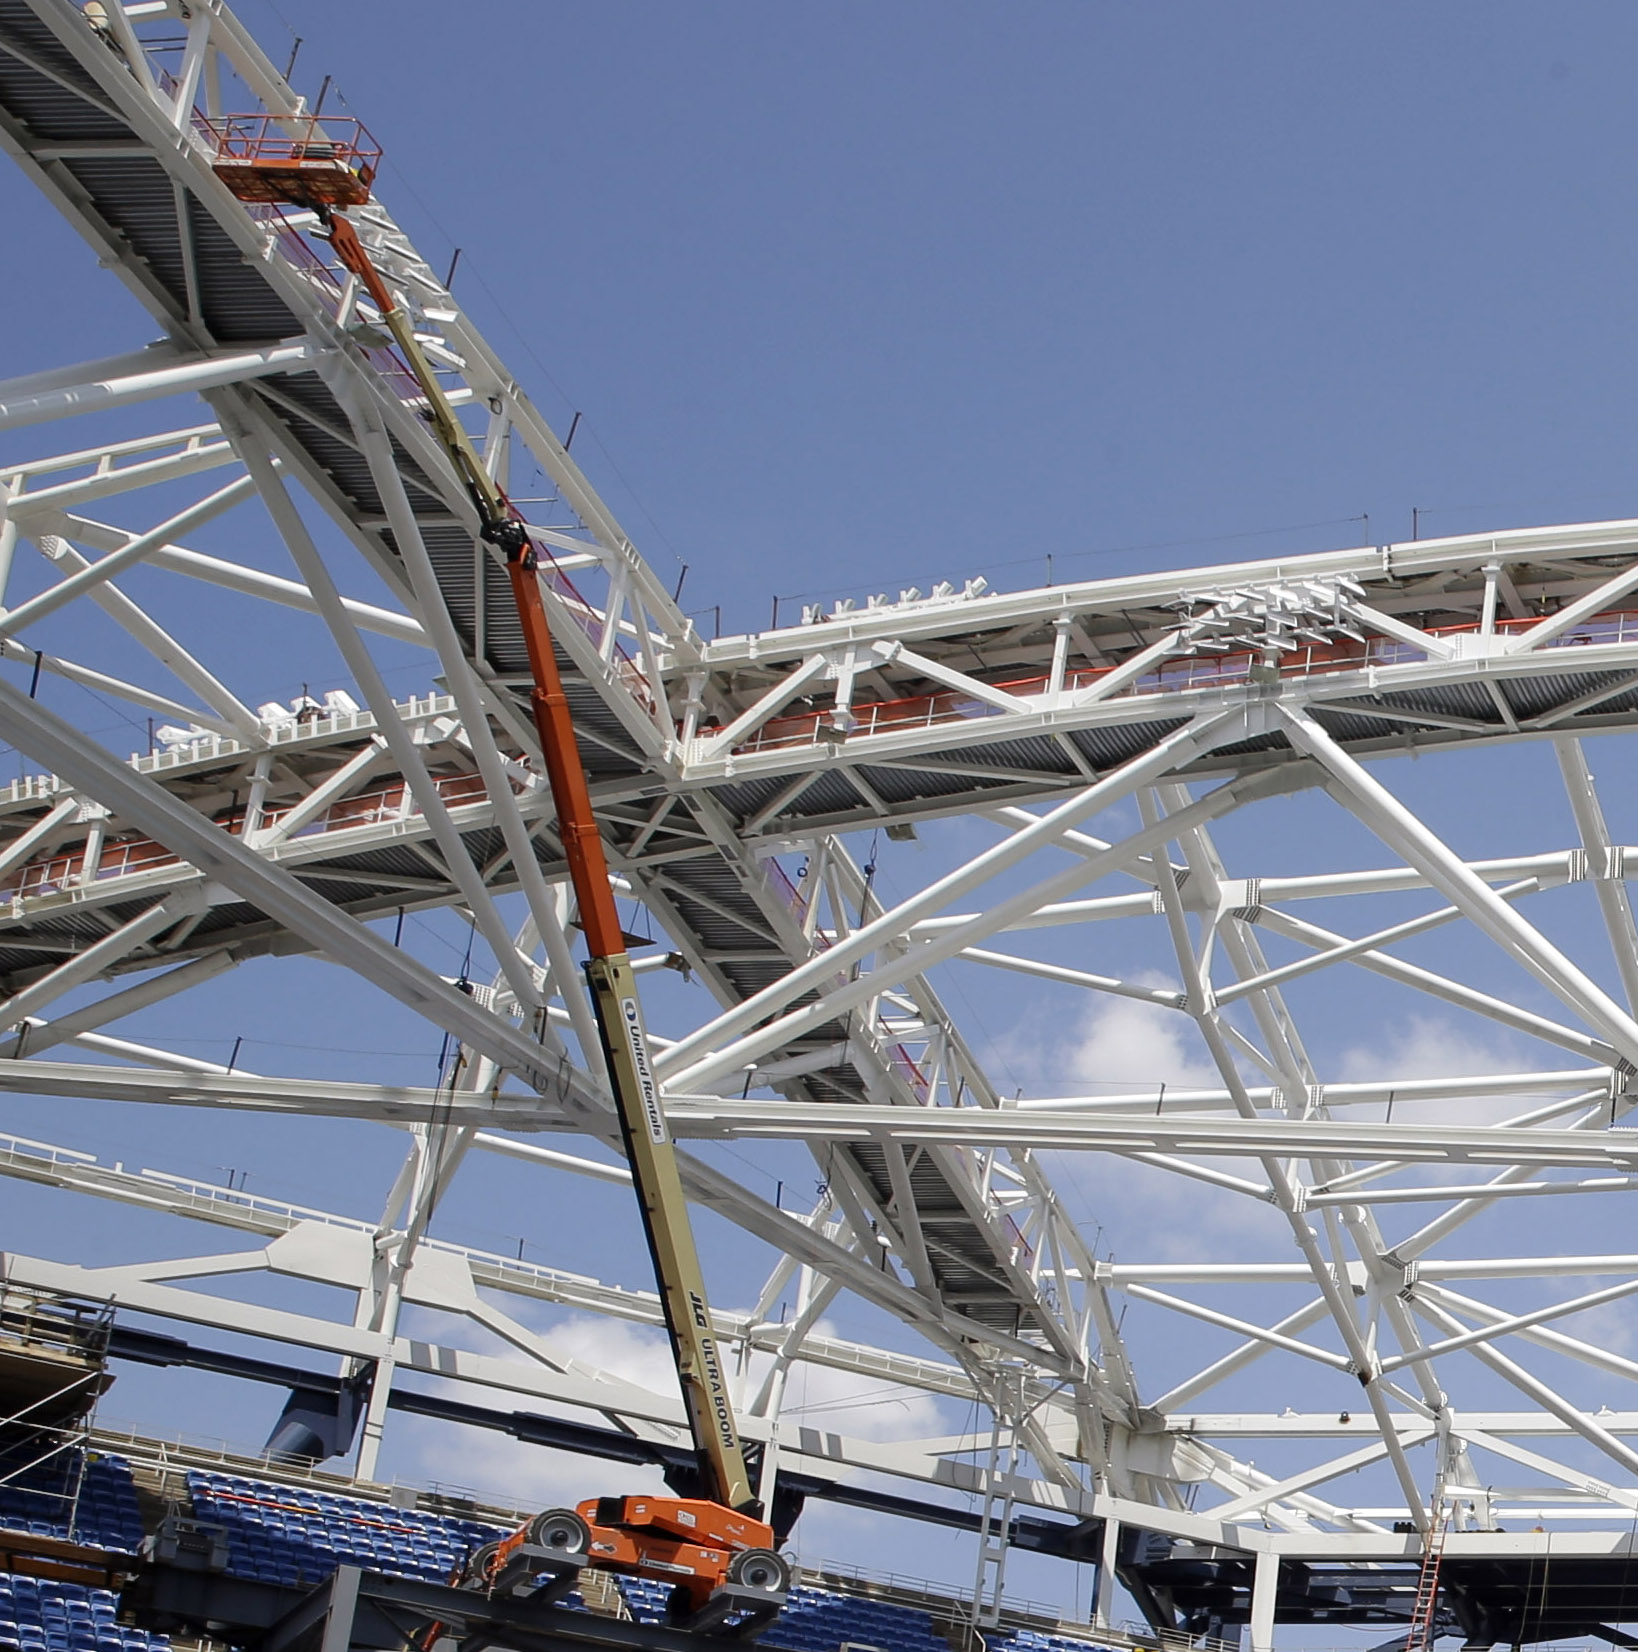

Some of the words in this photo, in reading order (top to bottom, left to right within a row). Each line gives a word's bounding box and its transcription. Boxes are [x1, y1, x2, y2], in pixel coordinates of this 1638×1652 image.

[629, 1024, 651, 1078] United
[643, 1078, 663, 1138] Rentals
[689, 1290, 707, 1329] JLG
[701, 1337, 722, 1392] ULTRA
[713, 1391, 734, 1448] BOOM
